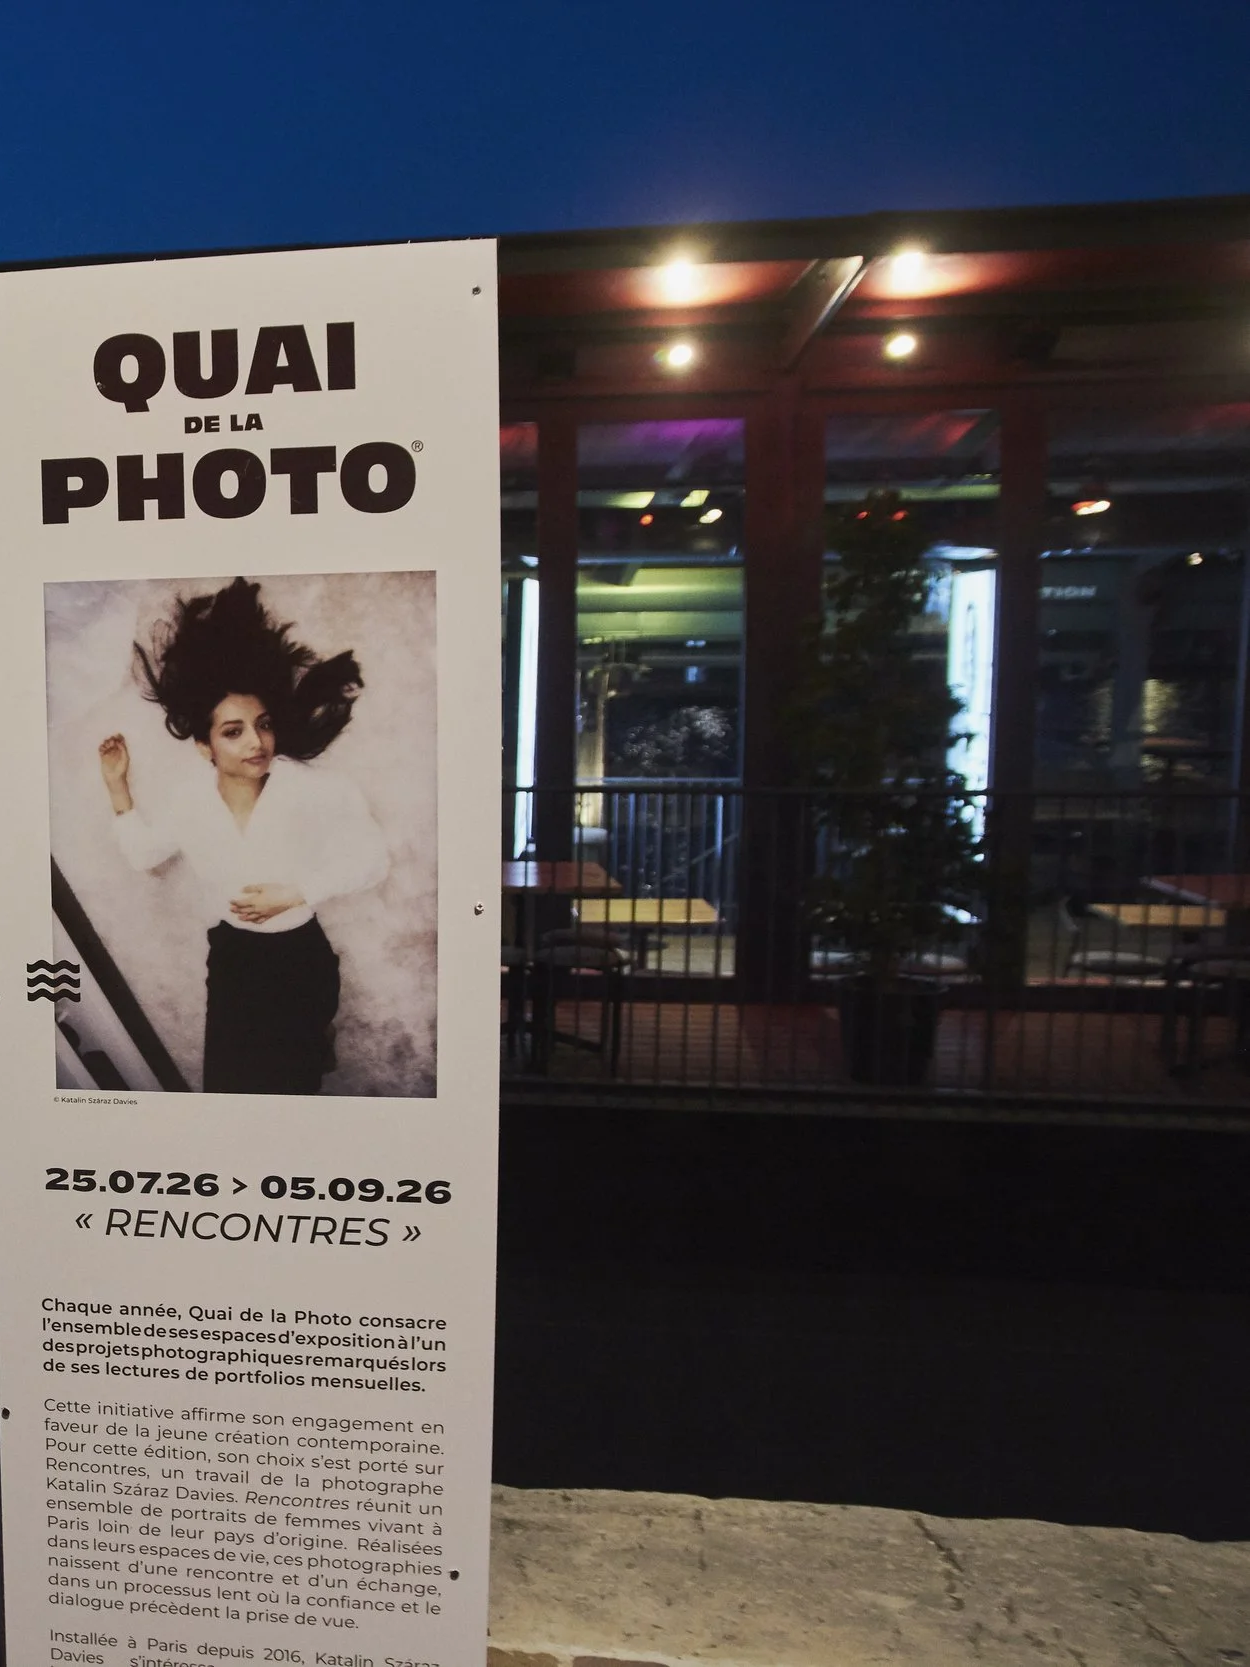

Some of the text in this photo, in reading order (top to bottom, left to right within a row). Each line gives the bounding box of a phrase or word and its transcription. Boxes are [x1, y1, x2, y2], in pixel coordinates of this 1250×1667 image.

[93, 321, 356, 413] QUAI
[184, 413, 264, 433] DE LA
[45, 1167, 220, 1196] 25.07.26
[261, 1174, 452, 1205] 05.09.26
[105, 1208, 391, 1246] RENCONTRES
[42, 1298, 446, 1330] Chaque année, Quai de la Photo consacre
[43, 1318, 446, 1351] l’ensemble de ses espaces d’exposition à l’un
[43, 1338, 446, 1376] des projets photographiques remarqués lors
[43, 1358, 425, 1392] de ses lectures de portfolios mensuelles.
[44, 1398, 444, 1434] Cette initiative affirme son engagement en
[44, 1418, 444, 1454] faveur de la jeune création contemporaine.
[46, 1438, 444, 1475] Pour cette édition, son choix s’est porté sur
[46, 1458, 443, 1497] Rencontres, un travail de la photographe
[47, 1477, 442, 1516] Katalin Száraz Davies. Rencontres réunit un
[46, 1499, 442, 1535] ensemble de portraits de femmes vivant à
[48, 1516, 442, 1556] Paris loin de leur pays d’origine. Réalisées
[48, 1535, 442, 1576] dans leurs espaces de vie, ces photographies
[48, 1573, 441, 1615] dans un processus lent où la confiance et le
[49, 1555, 441, 1597] naissent d’une rencontre et d’un échange,
[49, 1592, 358, 1628] dialogue précèdent la prise de vue.
[51, 1630, 118, 1647] Installée
[128, 1636, 136, 1648] à
[148, 1638, 187, 1653] Paris
[197, 1643, 254, 1659] depuis
[264, 1648, 304, 1665] 2016,
[316, 1652, 373, 1667] Katalin
[51, 1648, 104, 1664] Davies
